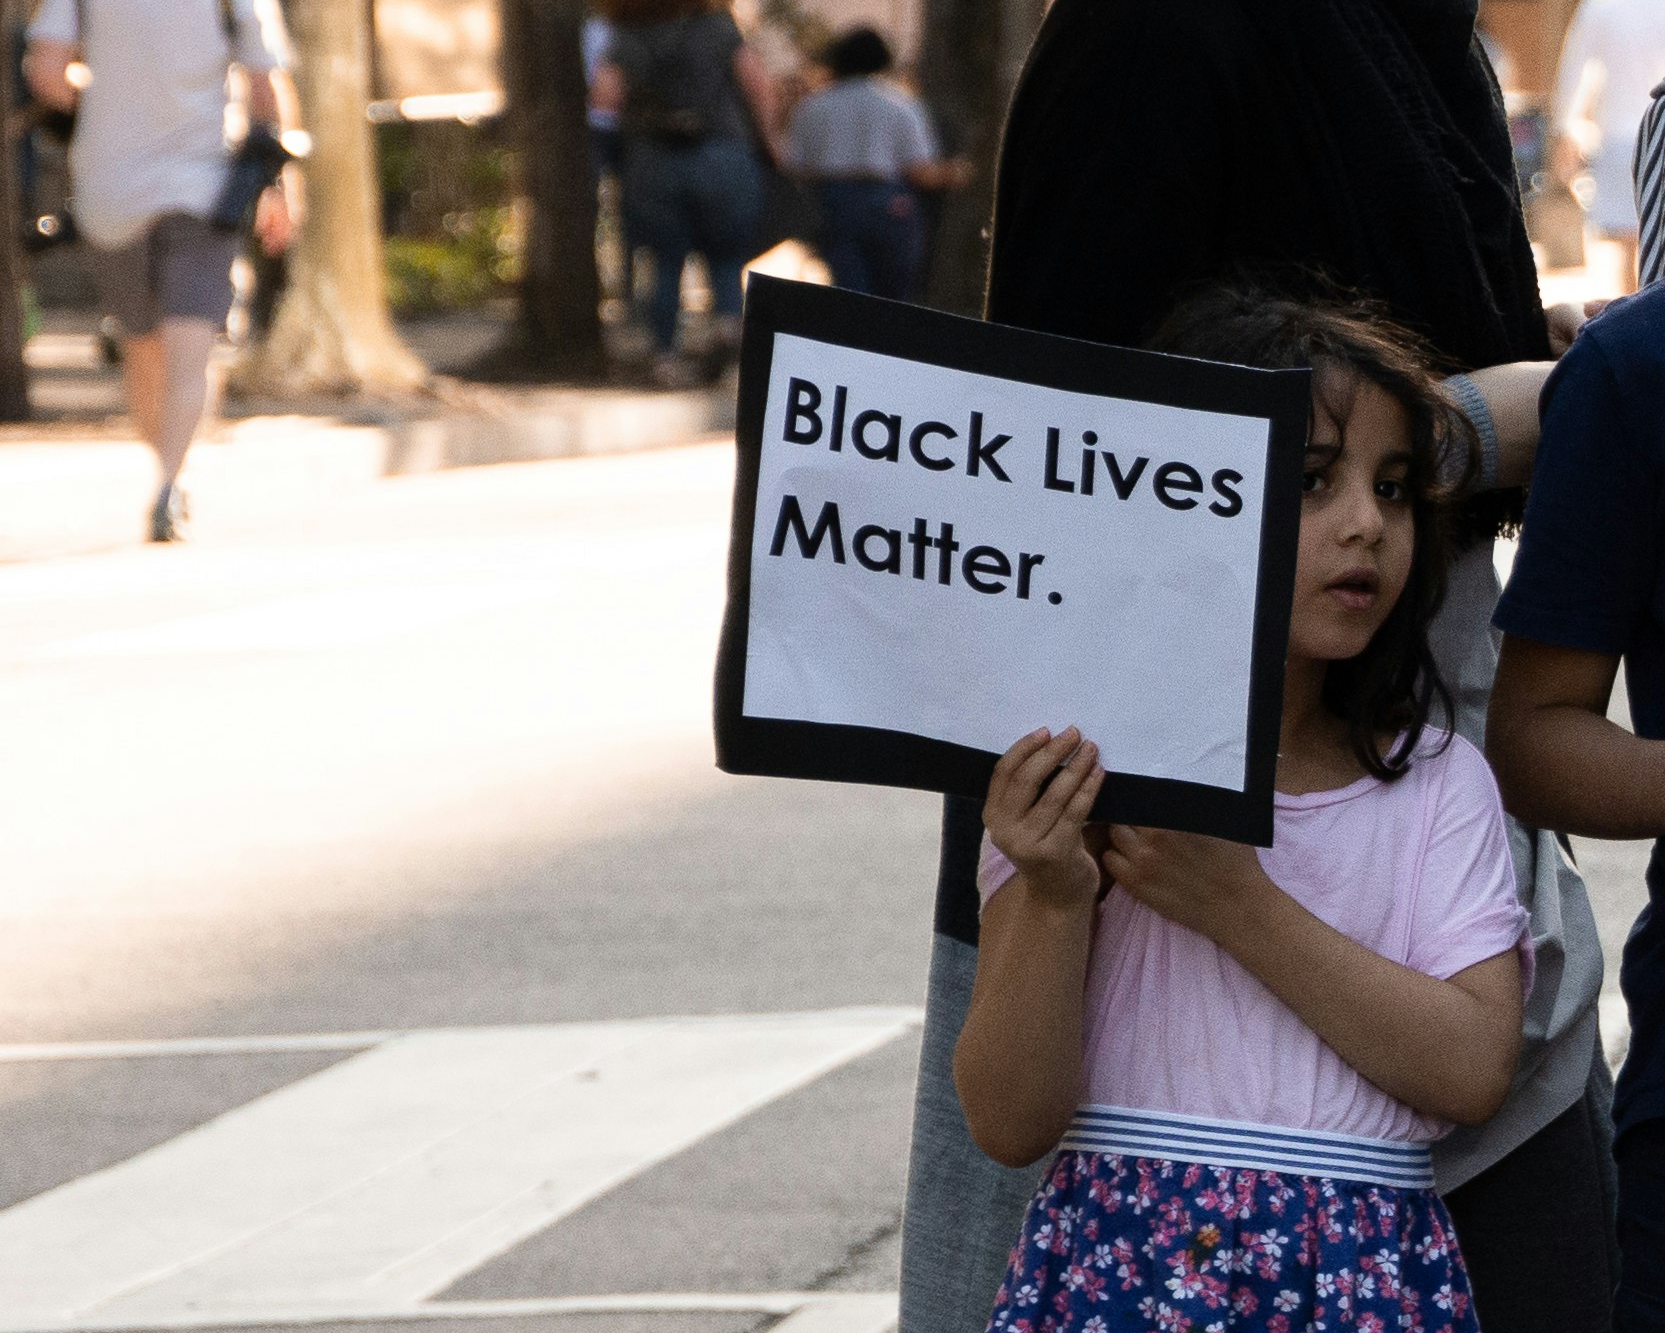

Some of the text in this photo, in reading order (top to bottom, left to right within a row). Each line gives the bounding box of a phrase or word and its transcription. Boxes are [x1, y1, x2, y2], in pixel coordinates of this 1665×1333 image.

[784, 378, 1242, 517] Black Lives
[770, 496, 1062, 604] Matter.
